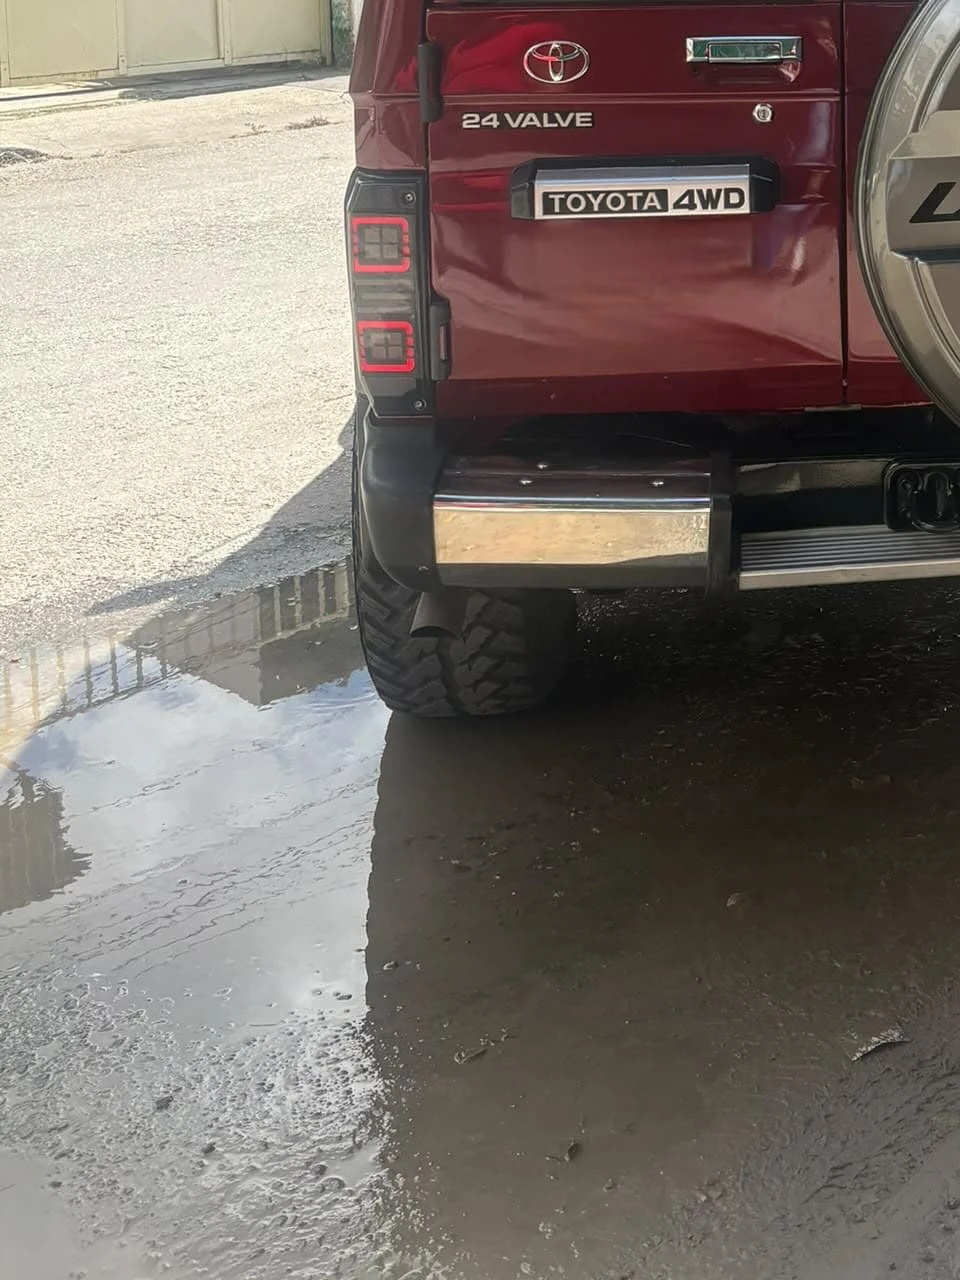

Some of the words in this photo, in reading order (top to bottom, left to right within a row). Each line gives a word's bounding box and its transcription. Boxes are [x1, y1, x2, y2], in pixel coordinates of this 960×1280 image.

[462, 113, 500, 128] 24
[504, 112, 593, 127] VALVE
[548, 191, 662, 214] TOYOTA
[672, 187, 746, 211] 4WD
